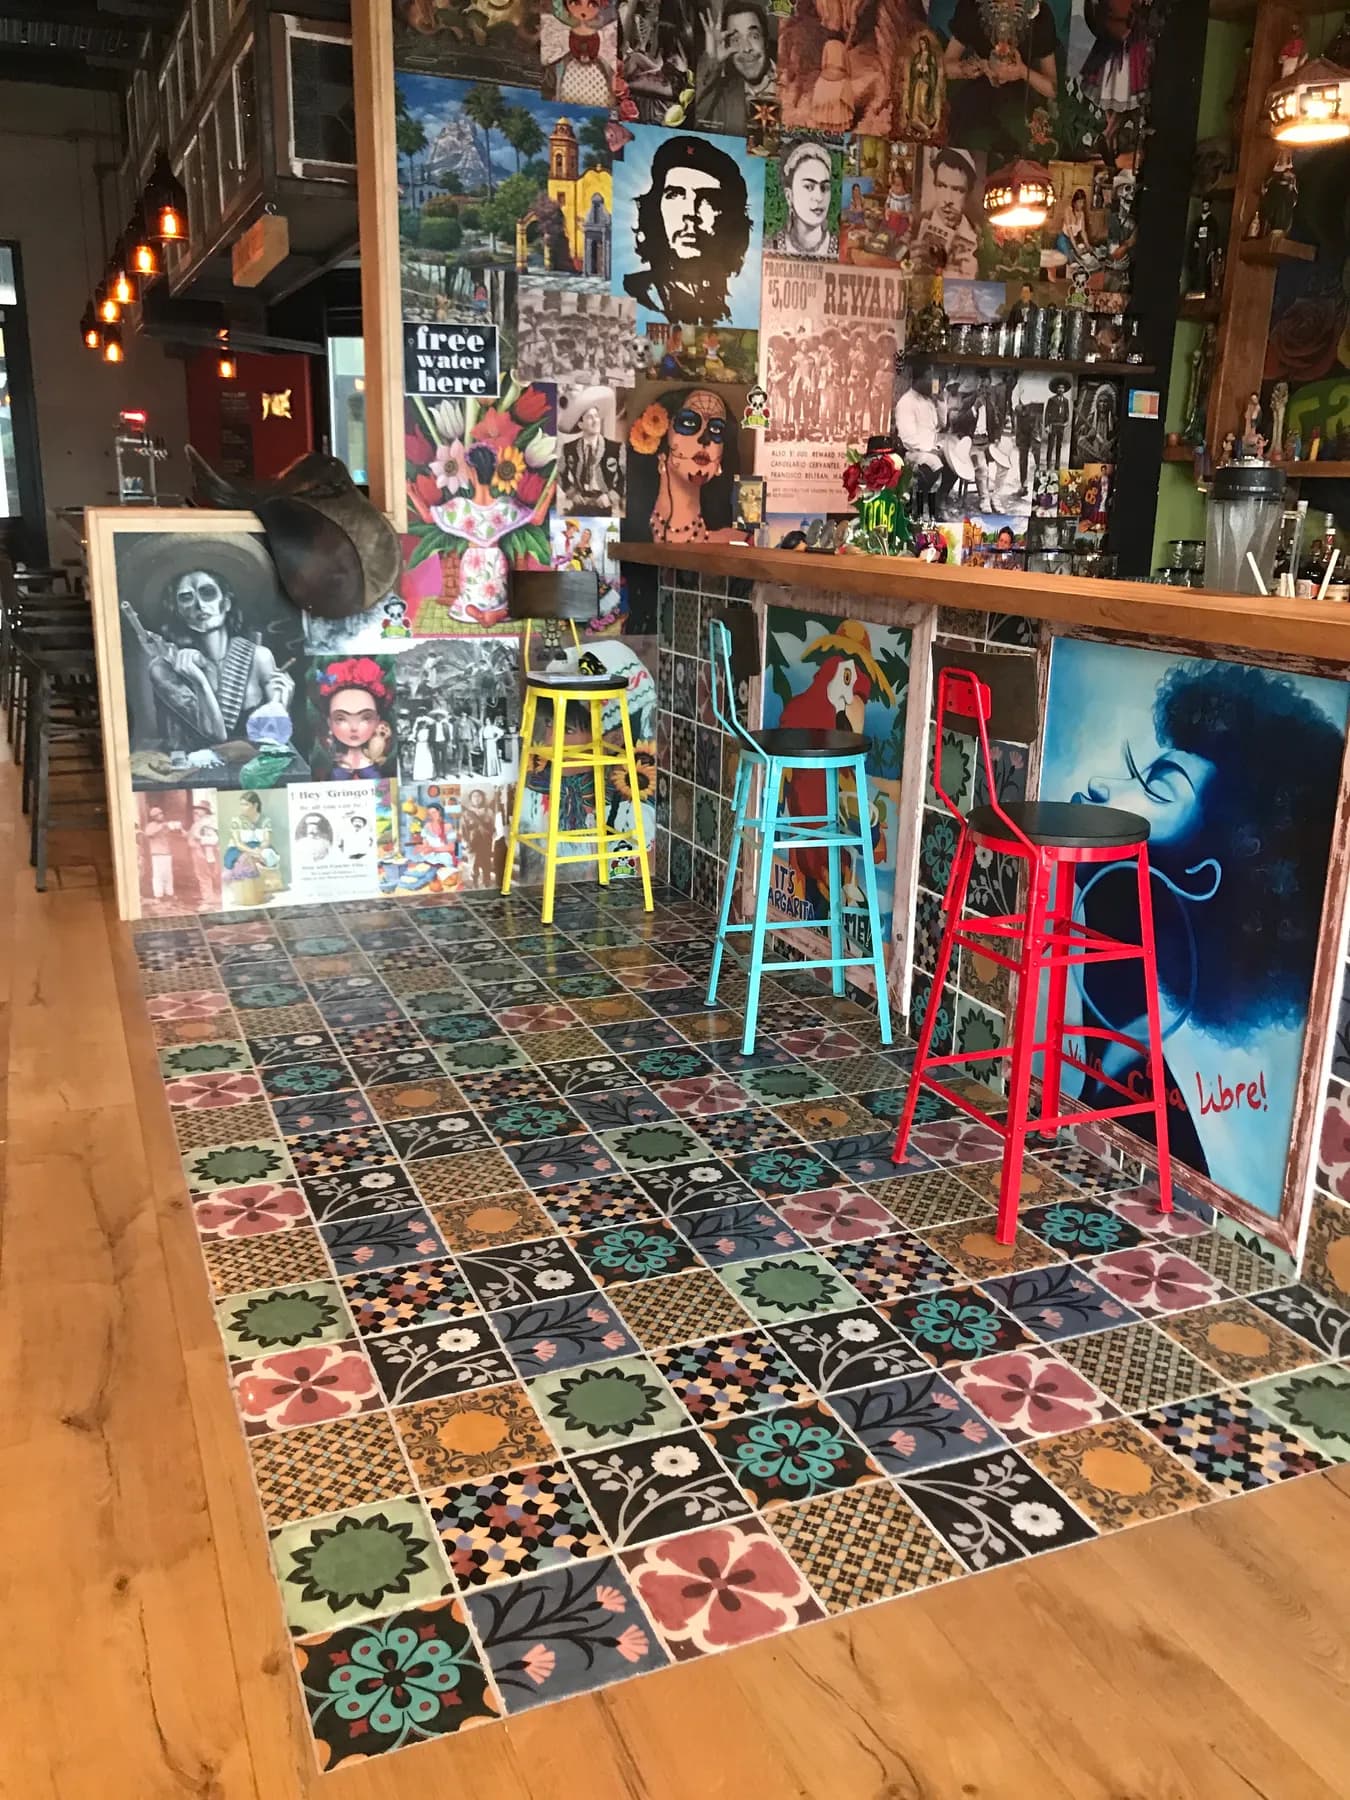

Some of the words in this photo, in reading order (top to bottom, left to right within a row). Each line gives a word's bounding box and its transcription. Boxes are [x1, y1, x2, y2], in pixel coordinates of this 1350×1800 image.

[764, 261, 823, 280] PROCLAMATION
[824, 272, 906, 320] REWARD
[416, 325, 485, 352] free
[416, 353, 486, 370] water
[417, 369, 486, 394] here
[774, 863, 796, 894] IT'S
[768, 886, 815, 921] ARGARITA
[1127, 1070, 1187, 1112] Ca
